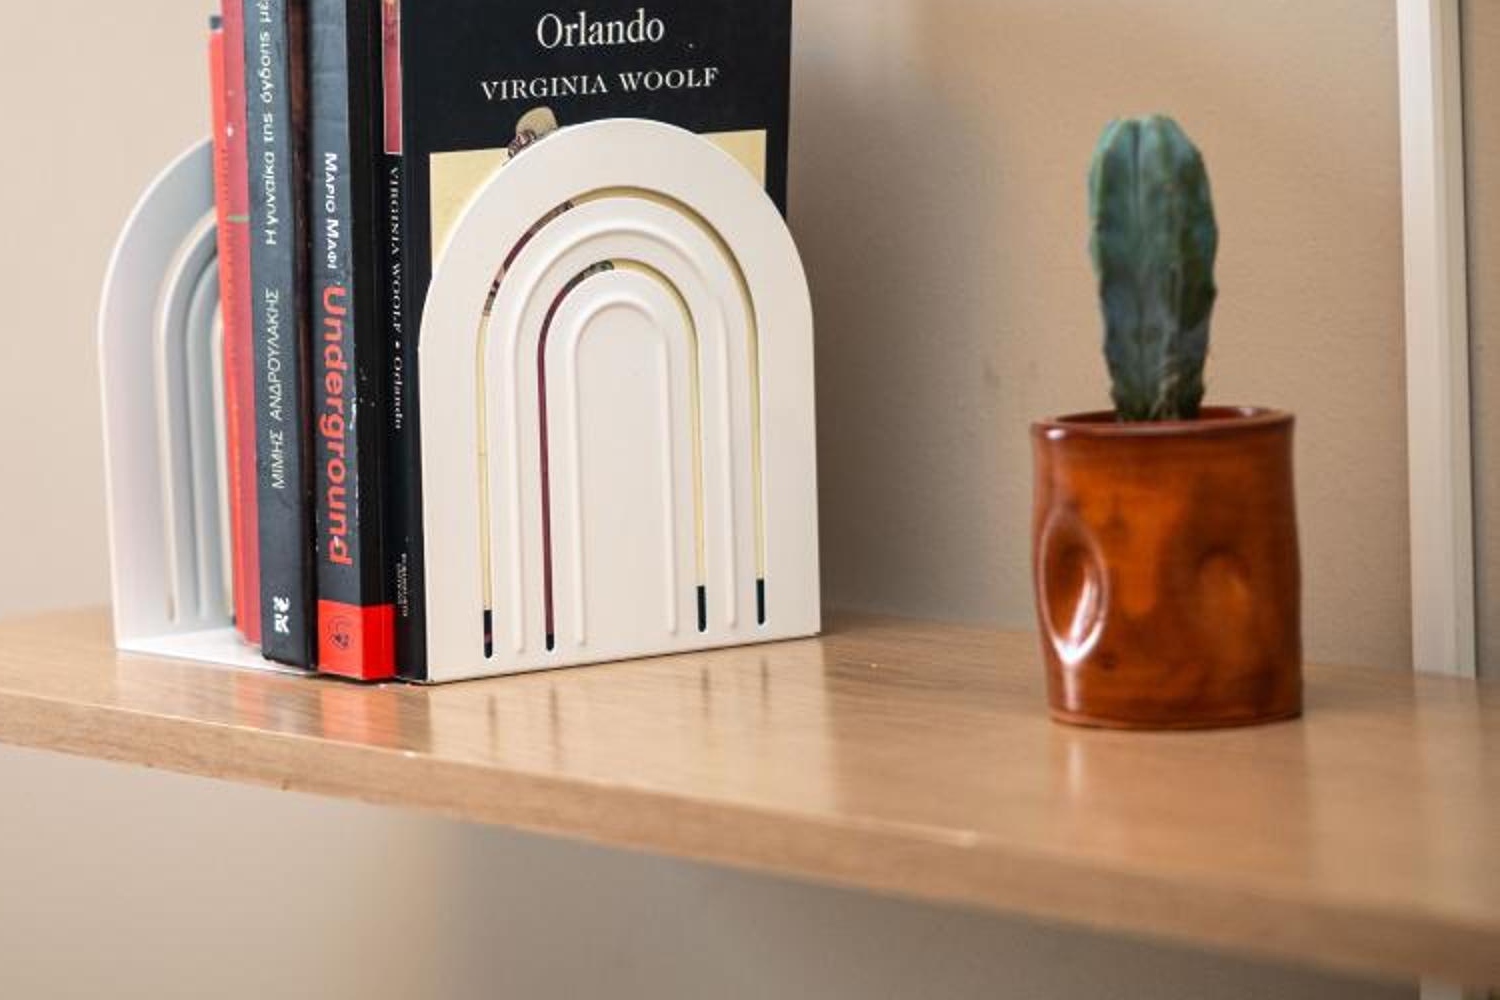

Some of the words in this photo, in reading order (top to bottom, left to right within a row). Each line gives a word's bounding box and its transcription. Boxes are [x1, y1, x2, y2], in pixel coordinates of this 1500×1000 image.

[536, 7, 665, 49] Orlando
[257, 31, 273, 103] όγδοης
[481, 74, 609, 100] VIRGINIA
[618, 67, 720, 93] WOOLF
[261, 113, 274, 143] της
[261, 152, 277, 226] γυναίκα
[389, 167, 400, 255] VIRGINIA
[391, 262, 402, 333] WOOLF
[265, 287, 283, 422] ΑΝΔΡΟΥΛΑΚΗΣ
[318, 286, 353, 567] Underground
[394, 355, 403, 429] Orlando
[269, 429, 285, 489] ΜΙΜΗΣ
